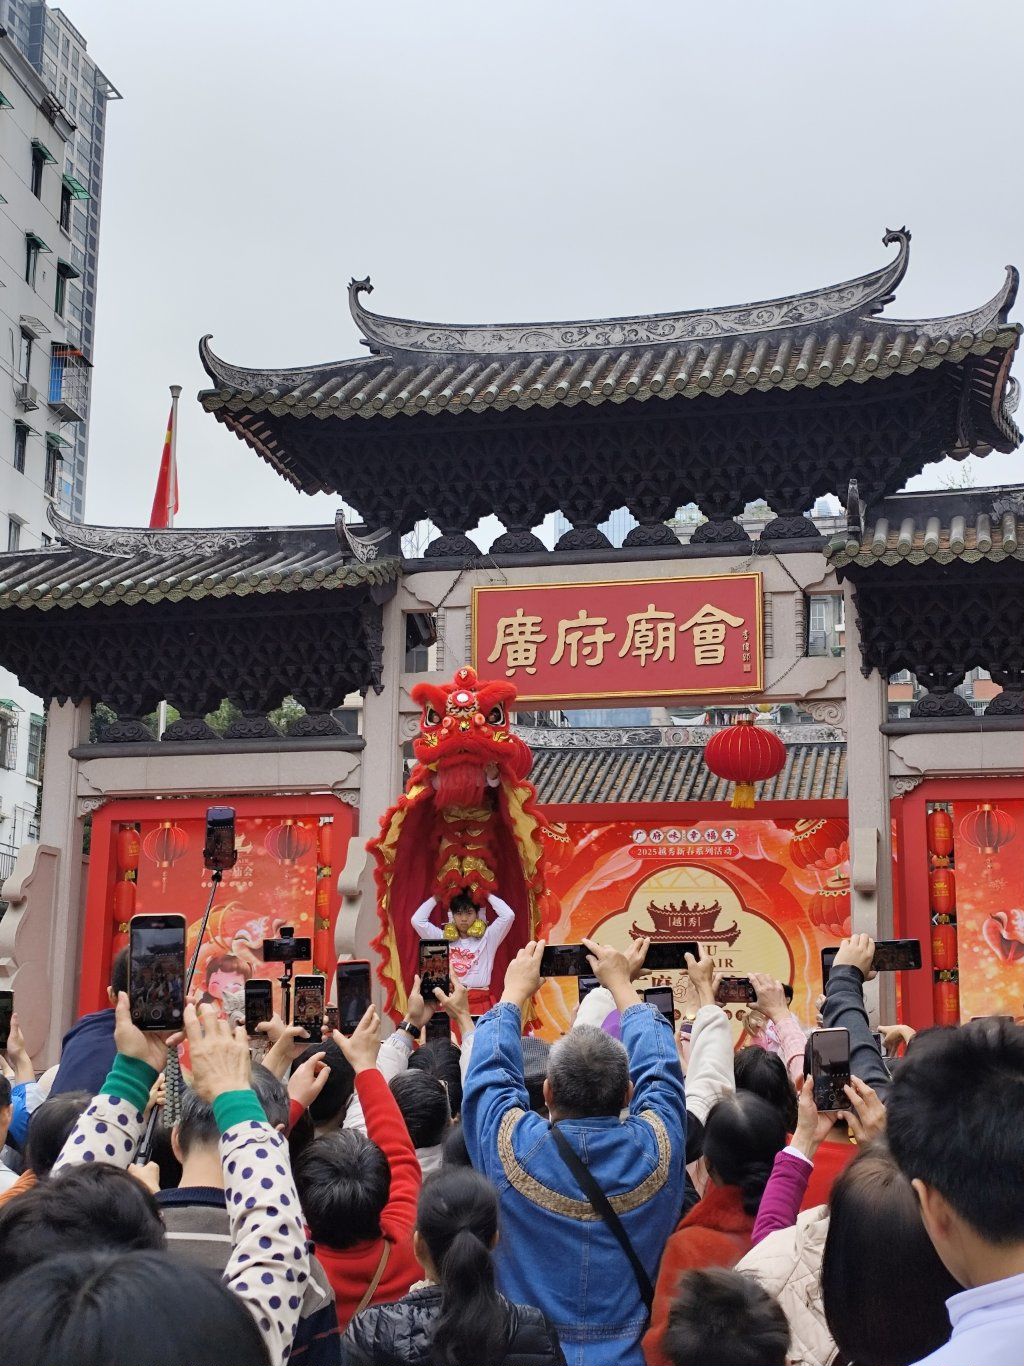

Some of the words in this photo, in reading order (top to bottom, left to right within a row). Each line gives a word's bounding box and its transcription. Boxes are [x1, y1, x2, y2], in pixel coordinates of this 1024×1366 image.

[487, 604, 745, 677] 廣府廟會
[689, 830, 734, 842] 幸福年
[672, 917, 697, 927] 越秀
